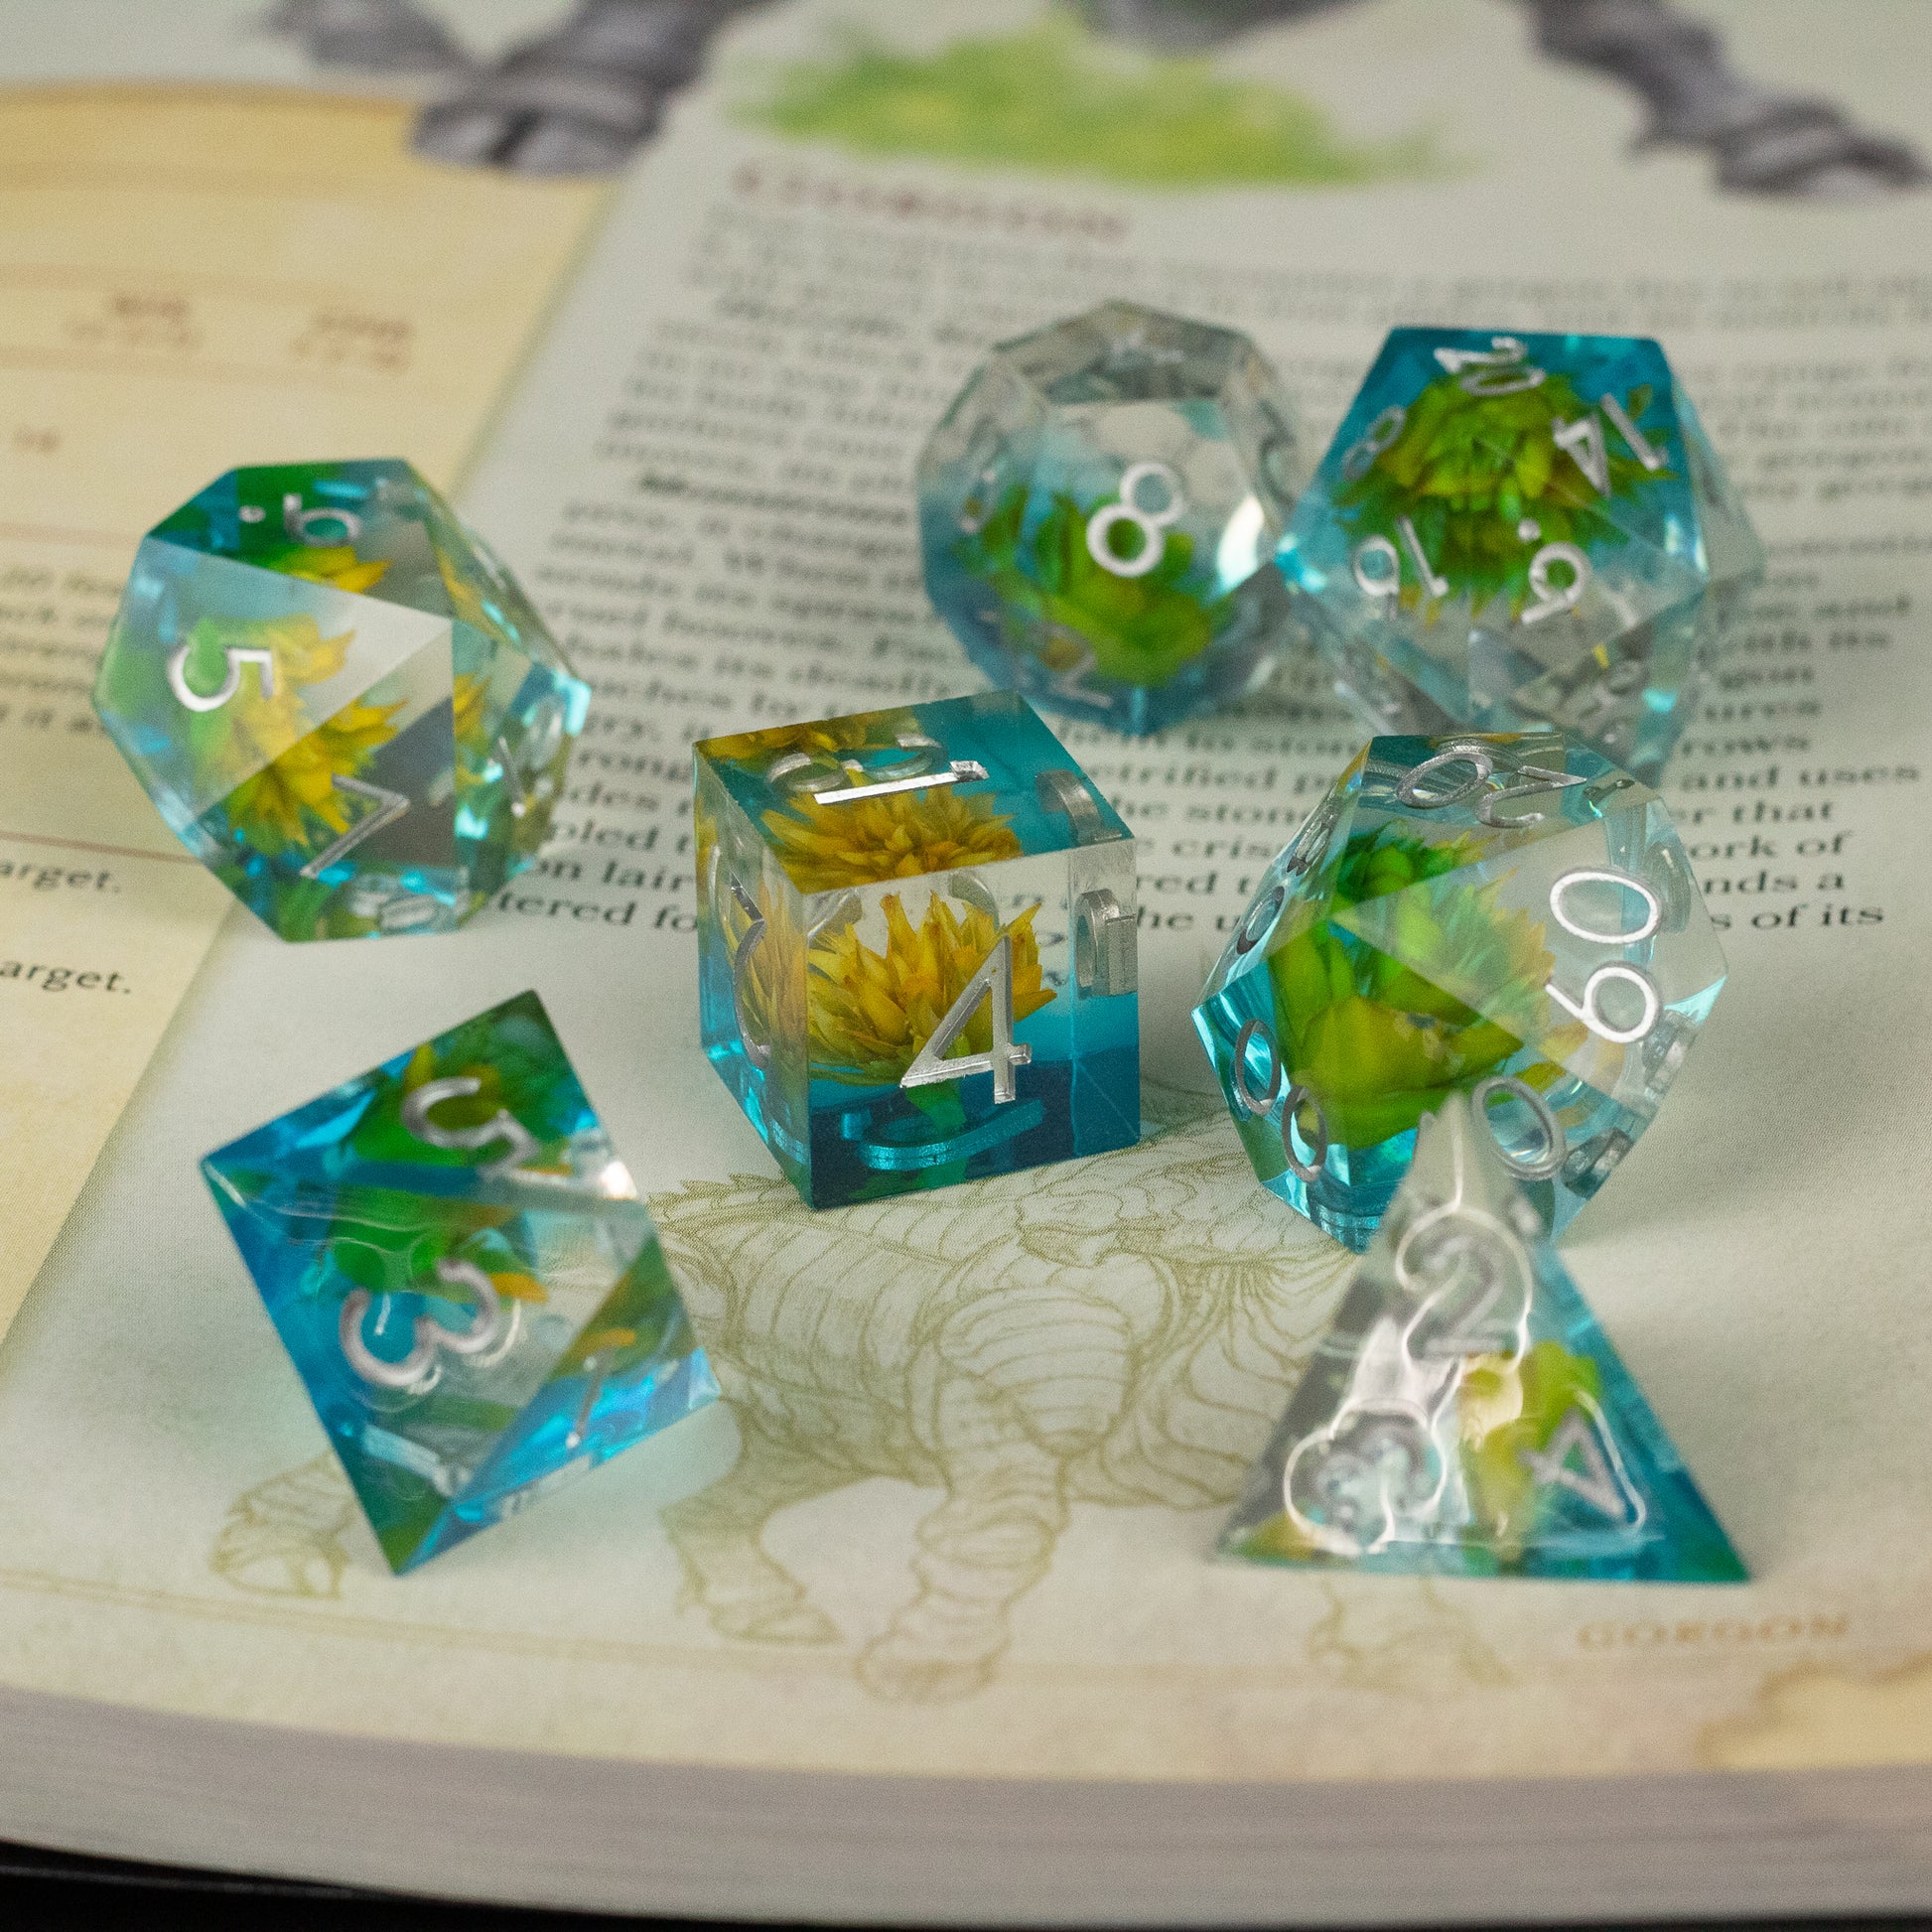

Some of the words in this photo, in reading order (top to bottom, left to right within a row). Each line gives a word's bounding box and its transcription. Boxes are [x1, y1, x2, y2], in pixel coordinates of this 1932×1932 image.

[1549, 391, 1670, 498] 14
[1084, 461, 1181, 579] 8
[165, 643, 275, 713] 5
[300, 772, 411, 879] 7
[1731, 800, 1835, 825] that
[1795, 829, 1857, 866] of
[1544, 866, 1666, 1044] 60
[1749, 902, 1810, 930] of
[1819, 903, 1886, 929] its
[900, 935, 1033, 1105] 4
[338, 1257, 501, 1388] 3
[1575, 1611, 1853, 1650] GORGON
